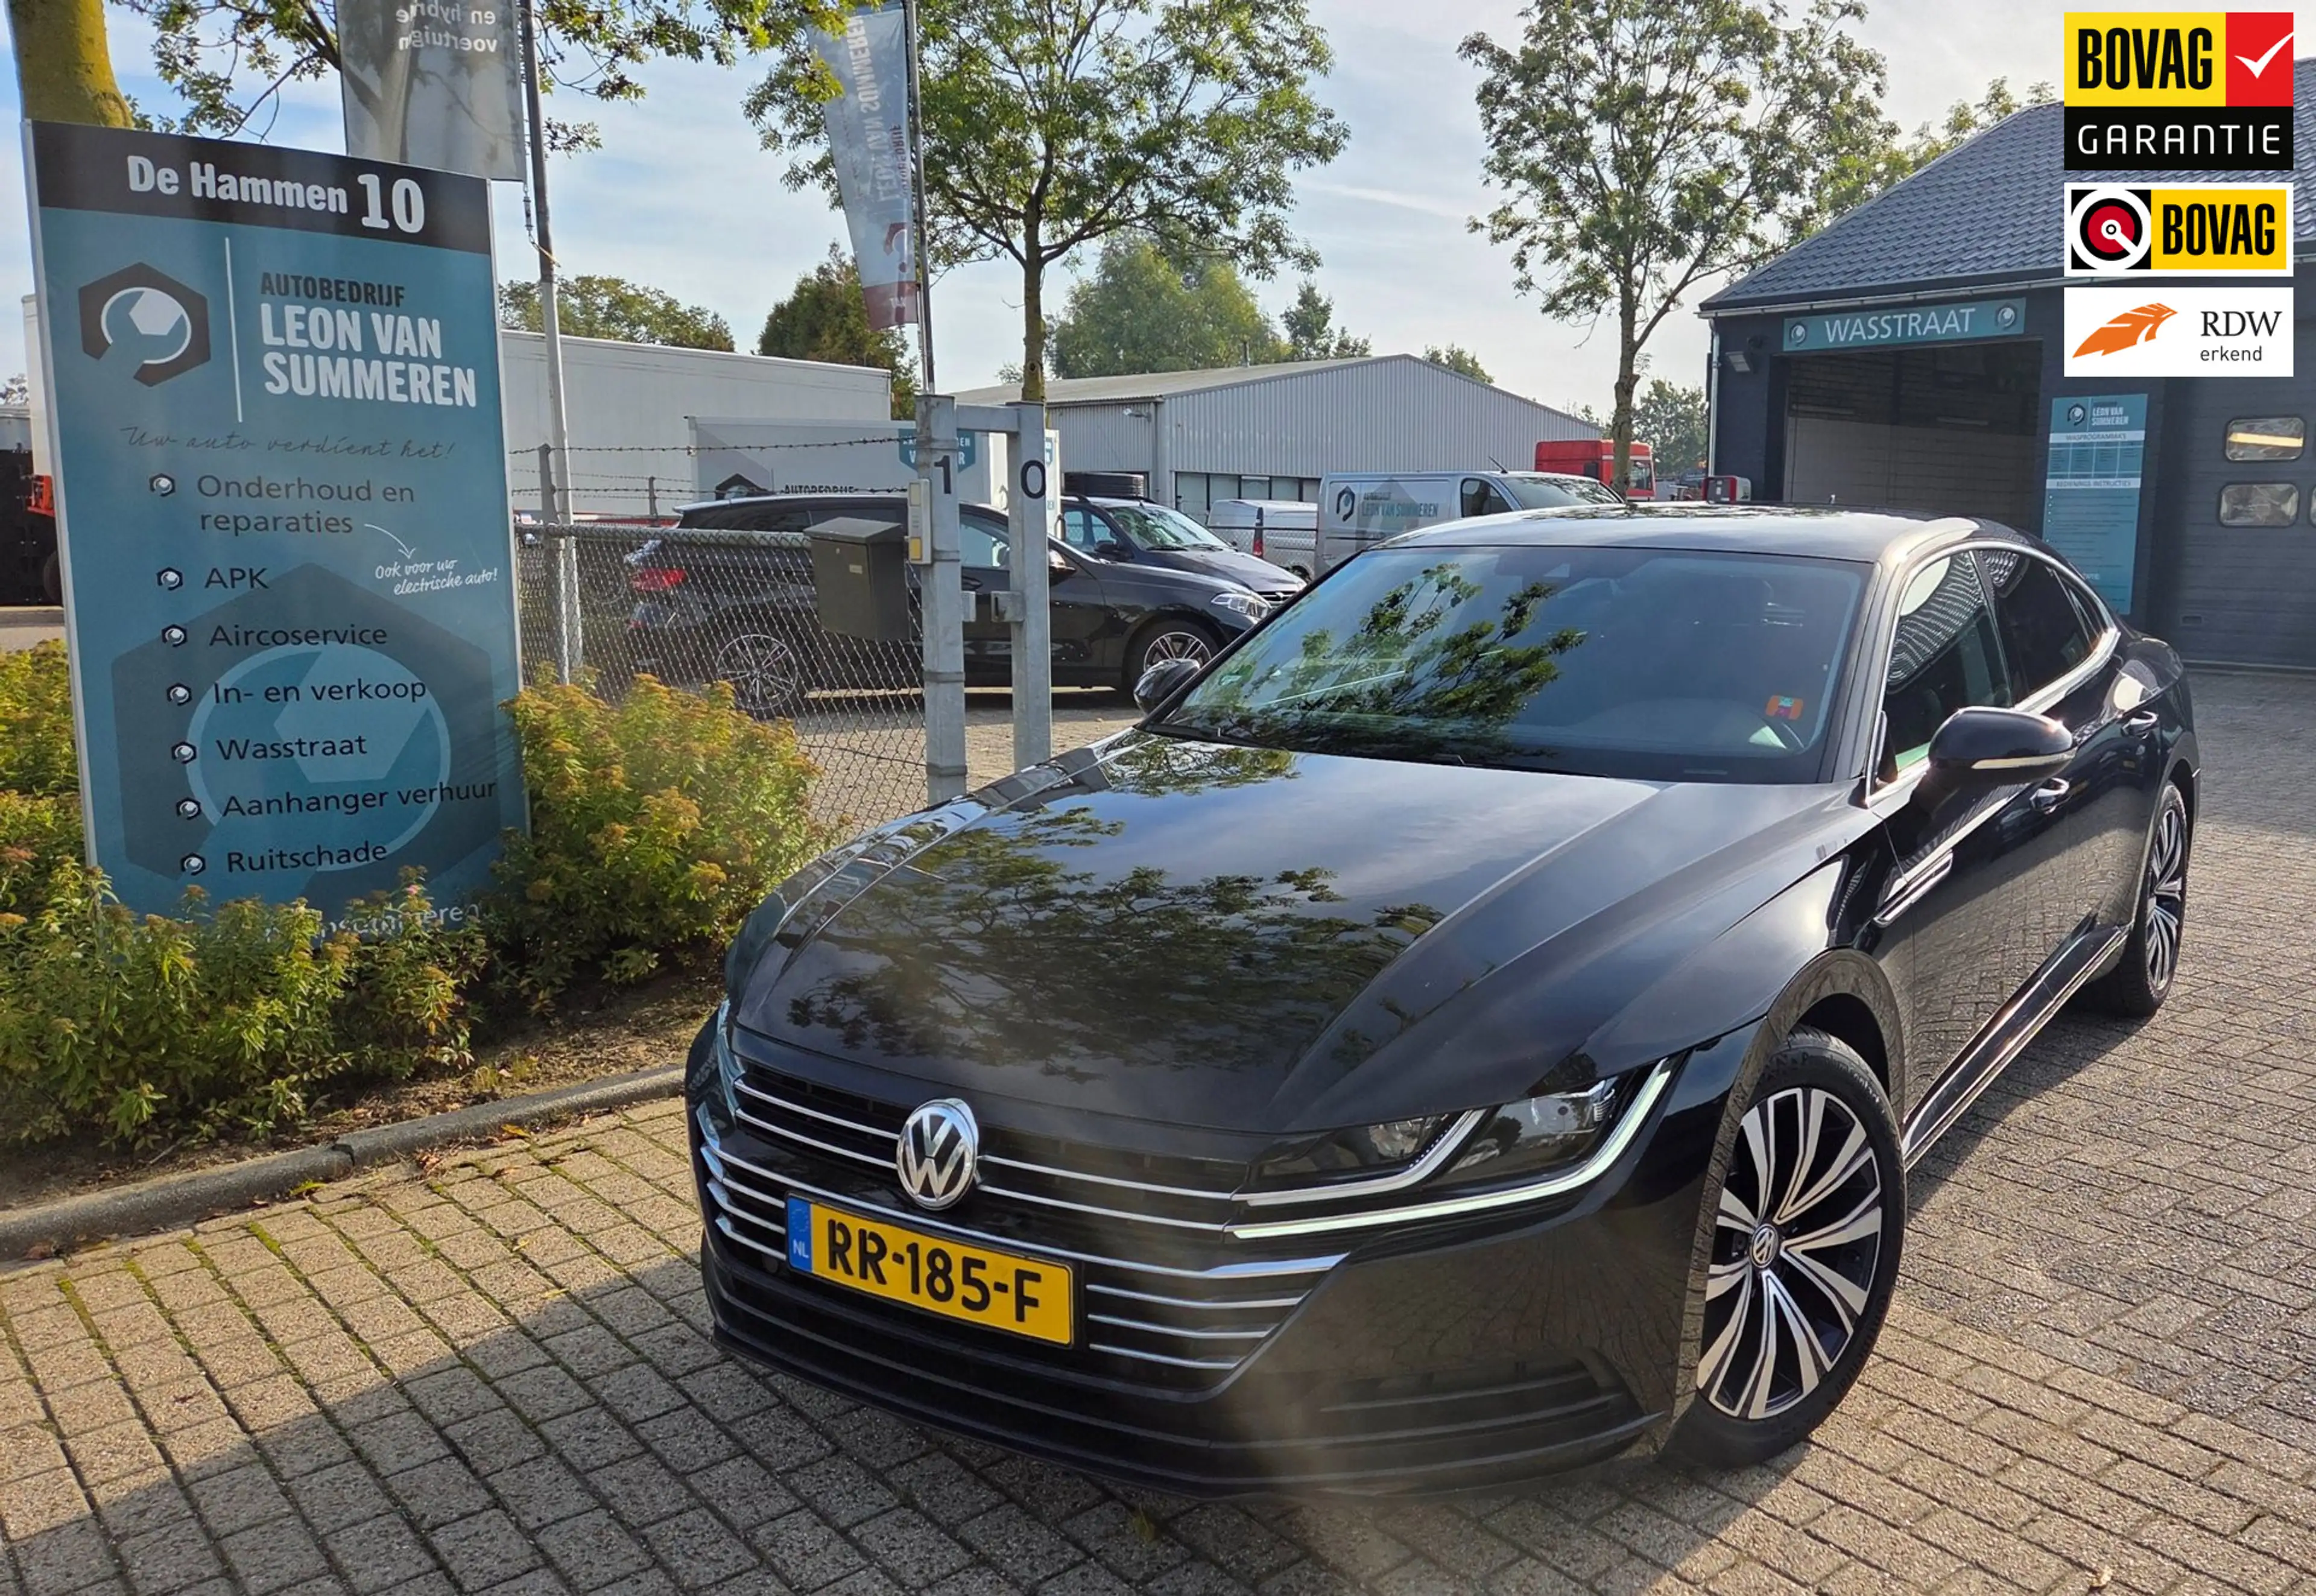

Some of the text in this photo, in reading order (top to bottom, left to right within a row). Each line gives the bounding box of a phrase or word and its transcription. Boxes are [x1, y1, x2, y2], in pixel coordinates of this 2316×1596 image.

[127, 155, 425, 233] De Hammen 10
[261, 272, 405, 308] AUTOBEDRIJF
[261, 303, 441, 359] LEON VAN
[1824, 308, 1976, 343] WASSTRAAT
[264, 351, 476, 408] SUMMEREN
[121, 426, 455, 460] Uw auto verdient het!
[197, 474, 414, 504] Onderhoud en
[934, 455, 951, 494] 1
[200, 511, 353, 537] reparaties
[204, 568, 269, 590] APK
[375, 560, 458, 579] Ook voor uw
[393, 568, 498, 595] electrische auto!
[209, 625, 388, 647] Aircoservice
[214, 677, 427, 705] In- en verkoop
[216, 735, 368, 761] Wasstraat
[221, 780, 498, 817] Aanhanger verhuur
[228, 841, 388, 873] Ruitschade
[793, 1218, 1042, 1323] NL RR-185-F
